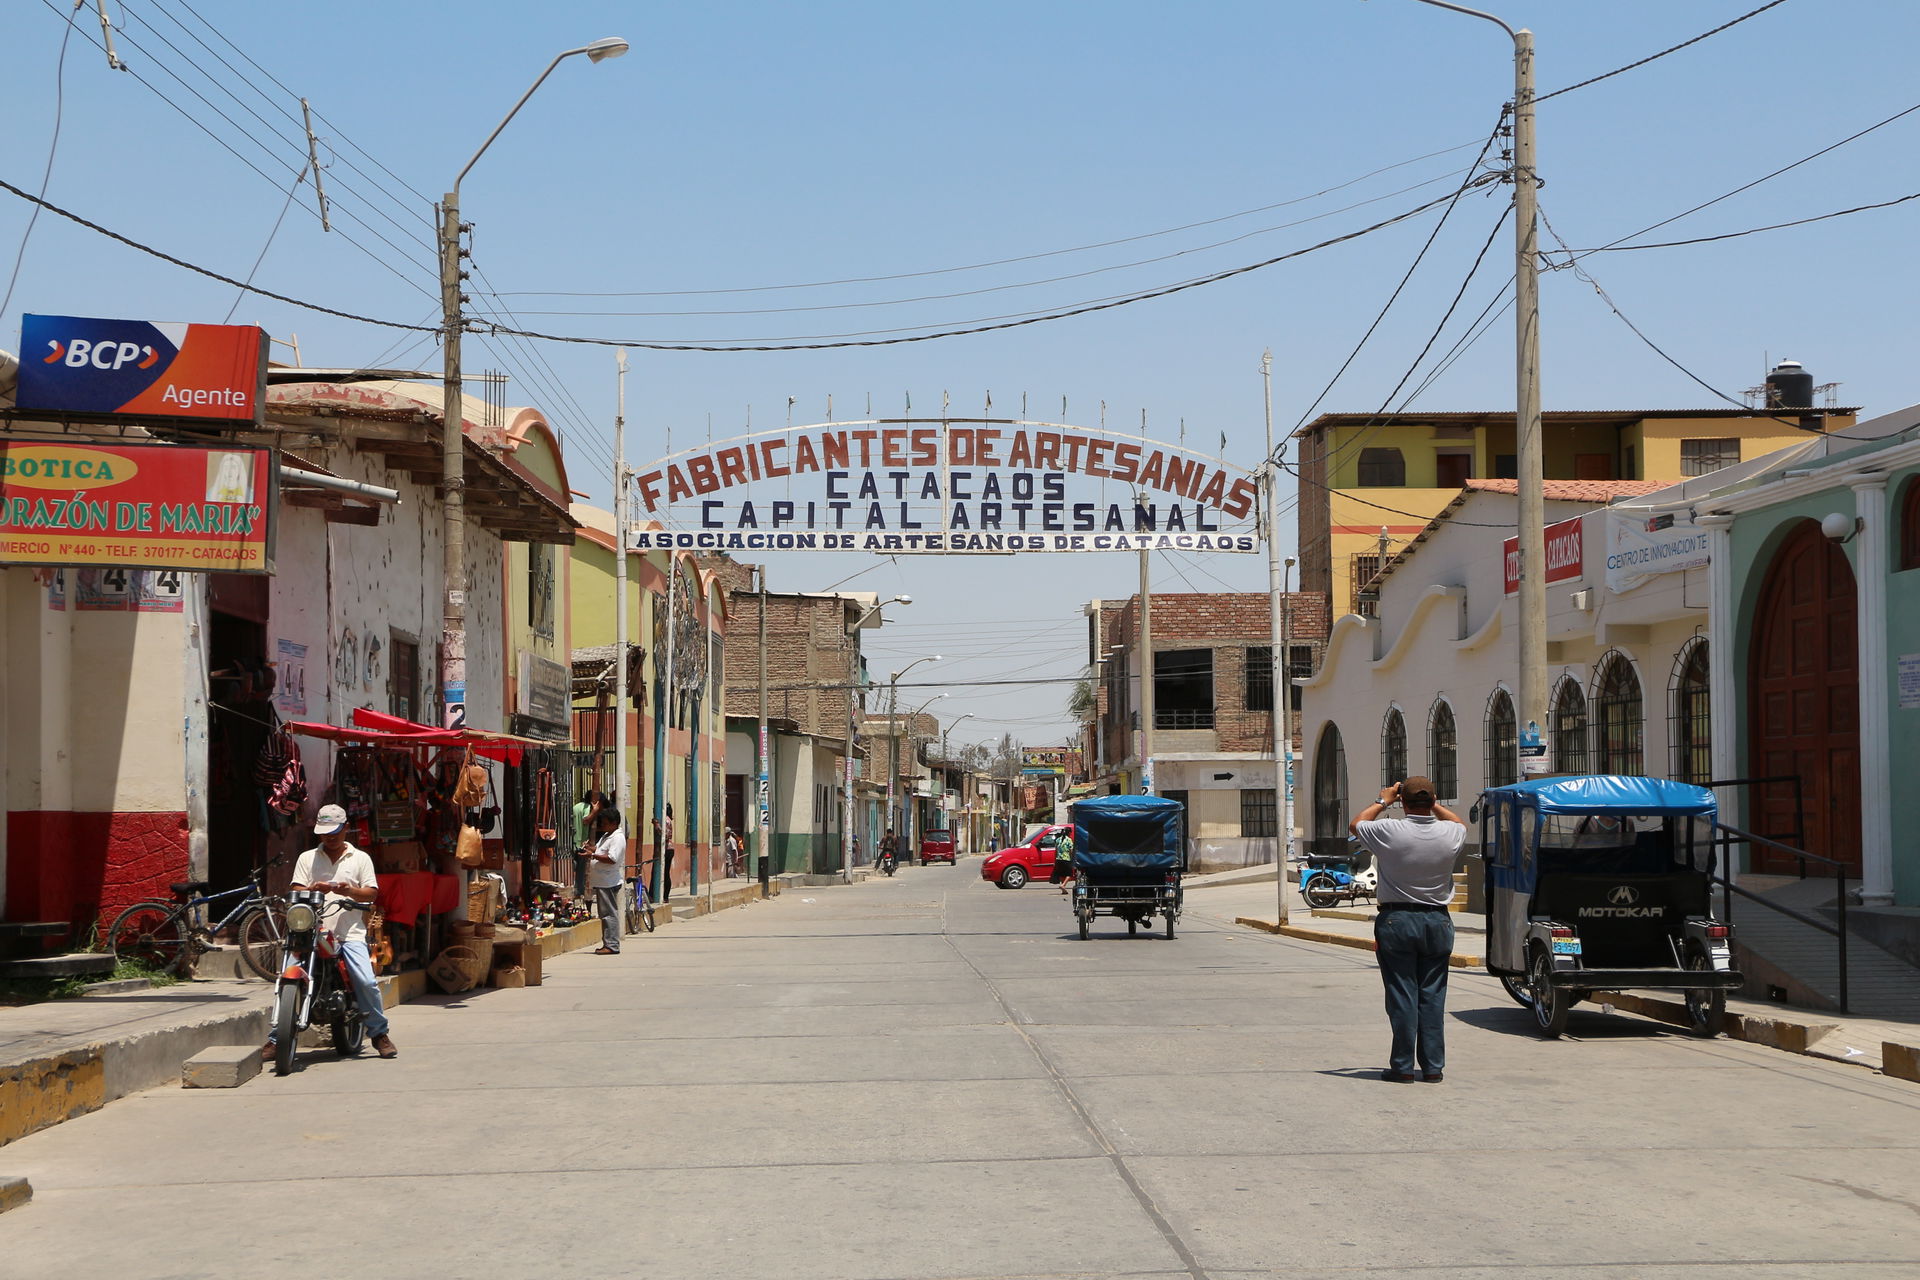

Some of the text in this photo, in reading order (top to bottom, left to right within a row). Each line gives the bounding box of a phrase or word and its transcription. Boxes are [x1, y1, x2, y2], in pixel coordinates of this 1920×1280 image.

[64, 339, 140, 370] BCP
[162, 384, 246, 408] Agente
[0, 457, 114, 480] BOTICA
[636, 429, 1258, 519] FABRICANTES DE ARTESANIAS
[826, 471, 1064, 500] CATACAOS
[115, 502, 152, 532] DE
[702, 501, 1217, 531] CAPITAL ARTESANAL
[105, 545, 137, 557] TELF.
[192, 548, 257, 560] CATACAOS
[636, 533, 816, 549] ASOCIACION
[823, 534, 855, 549] DE
[1054, 536, 1085, 550] DE
[1094, 535, 1253, 550] CATACAOS
[1547, 532, 1580, 570] CATACAOS
[1607, 551, 1638, 569] CENTRO
[1640, 548, 1649, 563] DE
[1650, 537, 1696, 560] INNOVACION
[103, 569, 127, 592] 4
[157, 571, 180, 594] 4
[449, 704, 465, 730] 2
[762, 781, 769, 792] 2
[762, 811, 769, 822] 2
[1578, 907, 1663, 918] MOTOKAR
